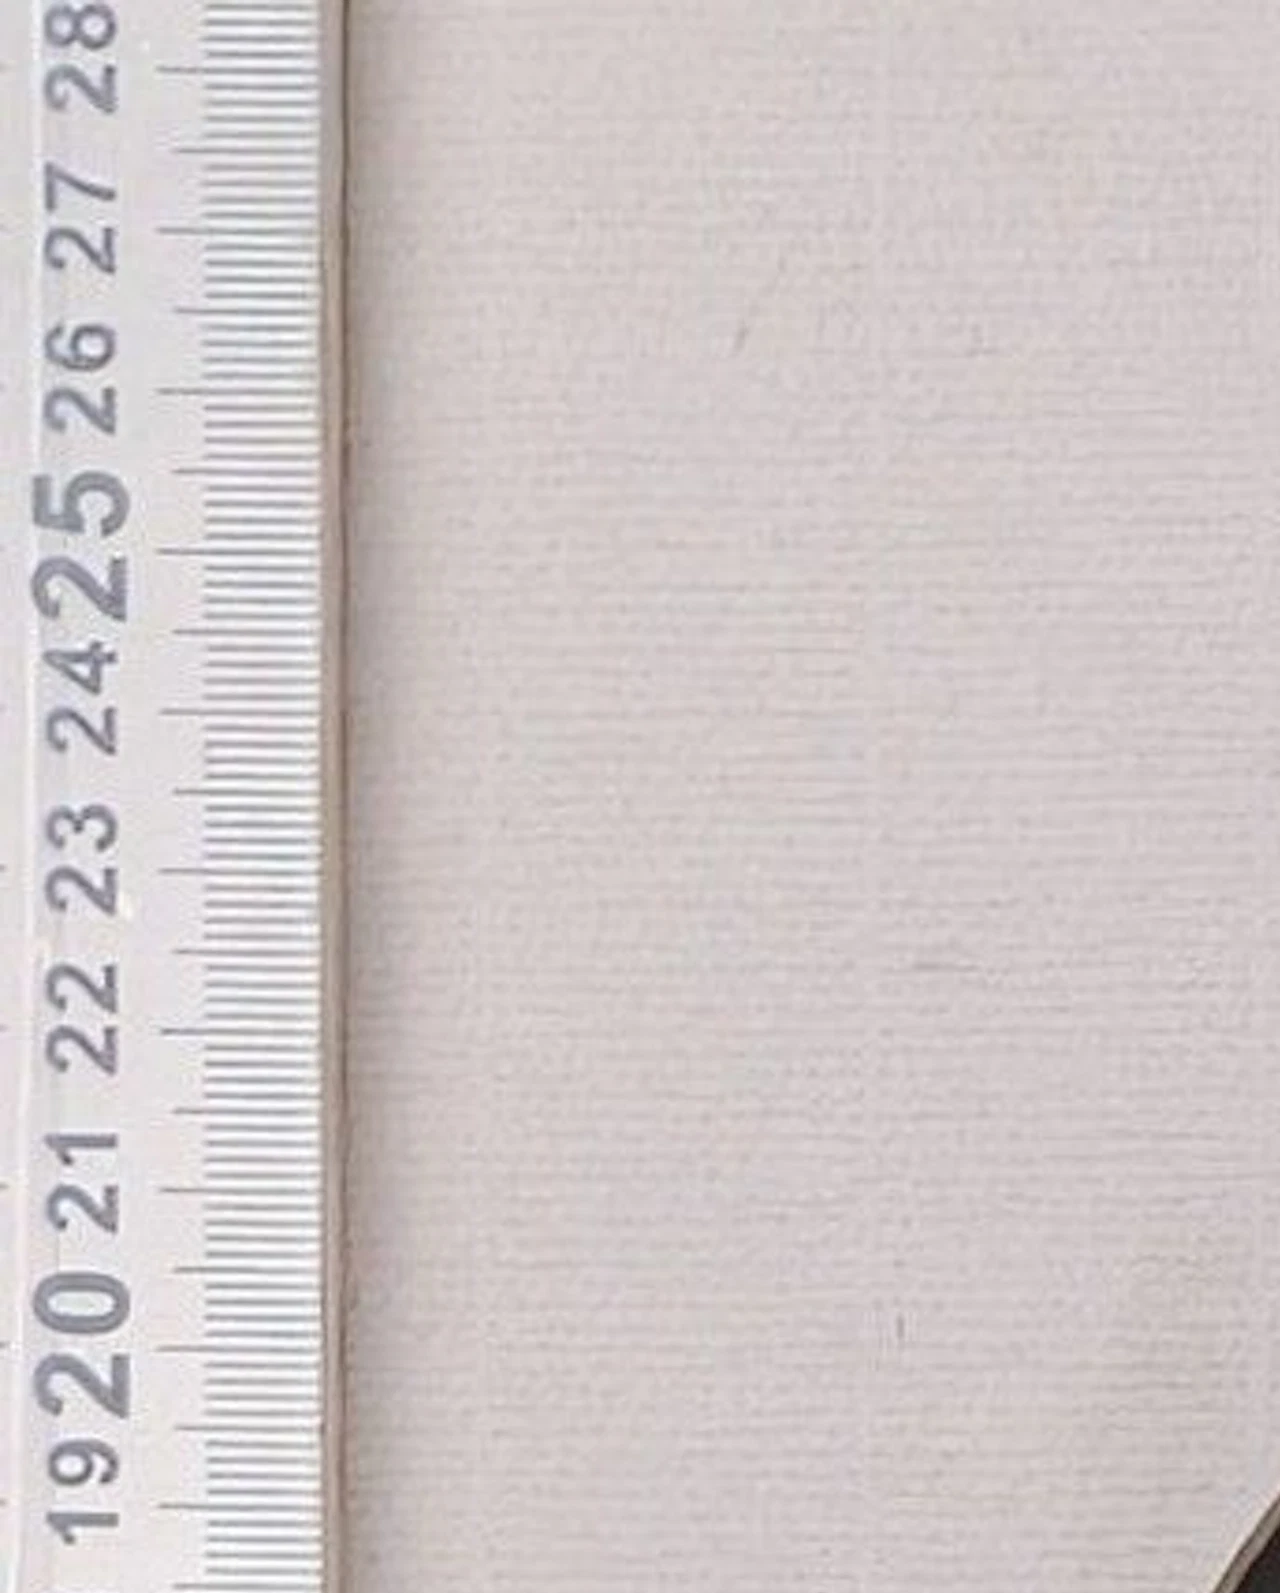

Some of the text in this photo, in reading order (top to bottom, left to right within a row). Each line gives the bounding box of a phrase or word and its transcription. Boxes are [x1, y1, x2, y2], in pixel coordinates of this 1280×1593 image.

[43, 2, 119, 115] 28
[42, 161, 118, 276] 27
[42, 323, 117, 436] 26
[29, 470, 130, 623] 25
[41, 639, 119, 757] 24
[43, 803, 119, 918] 23
[43, 962, 119, 1077] 22
[42, 1132, 120, 1236] 21
[29, 1270, 132, 1421] 20
[44, 1438, 121, 1546] 19
